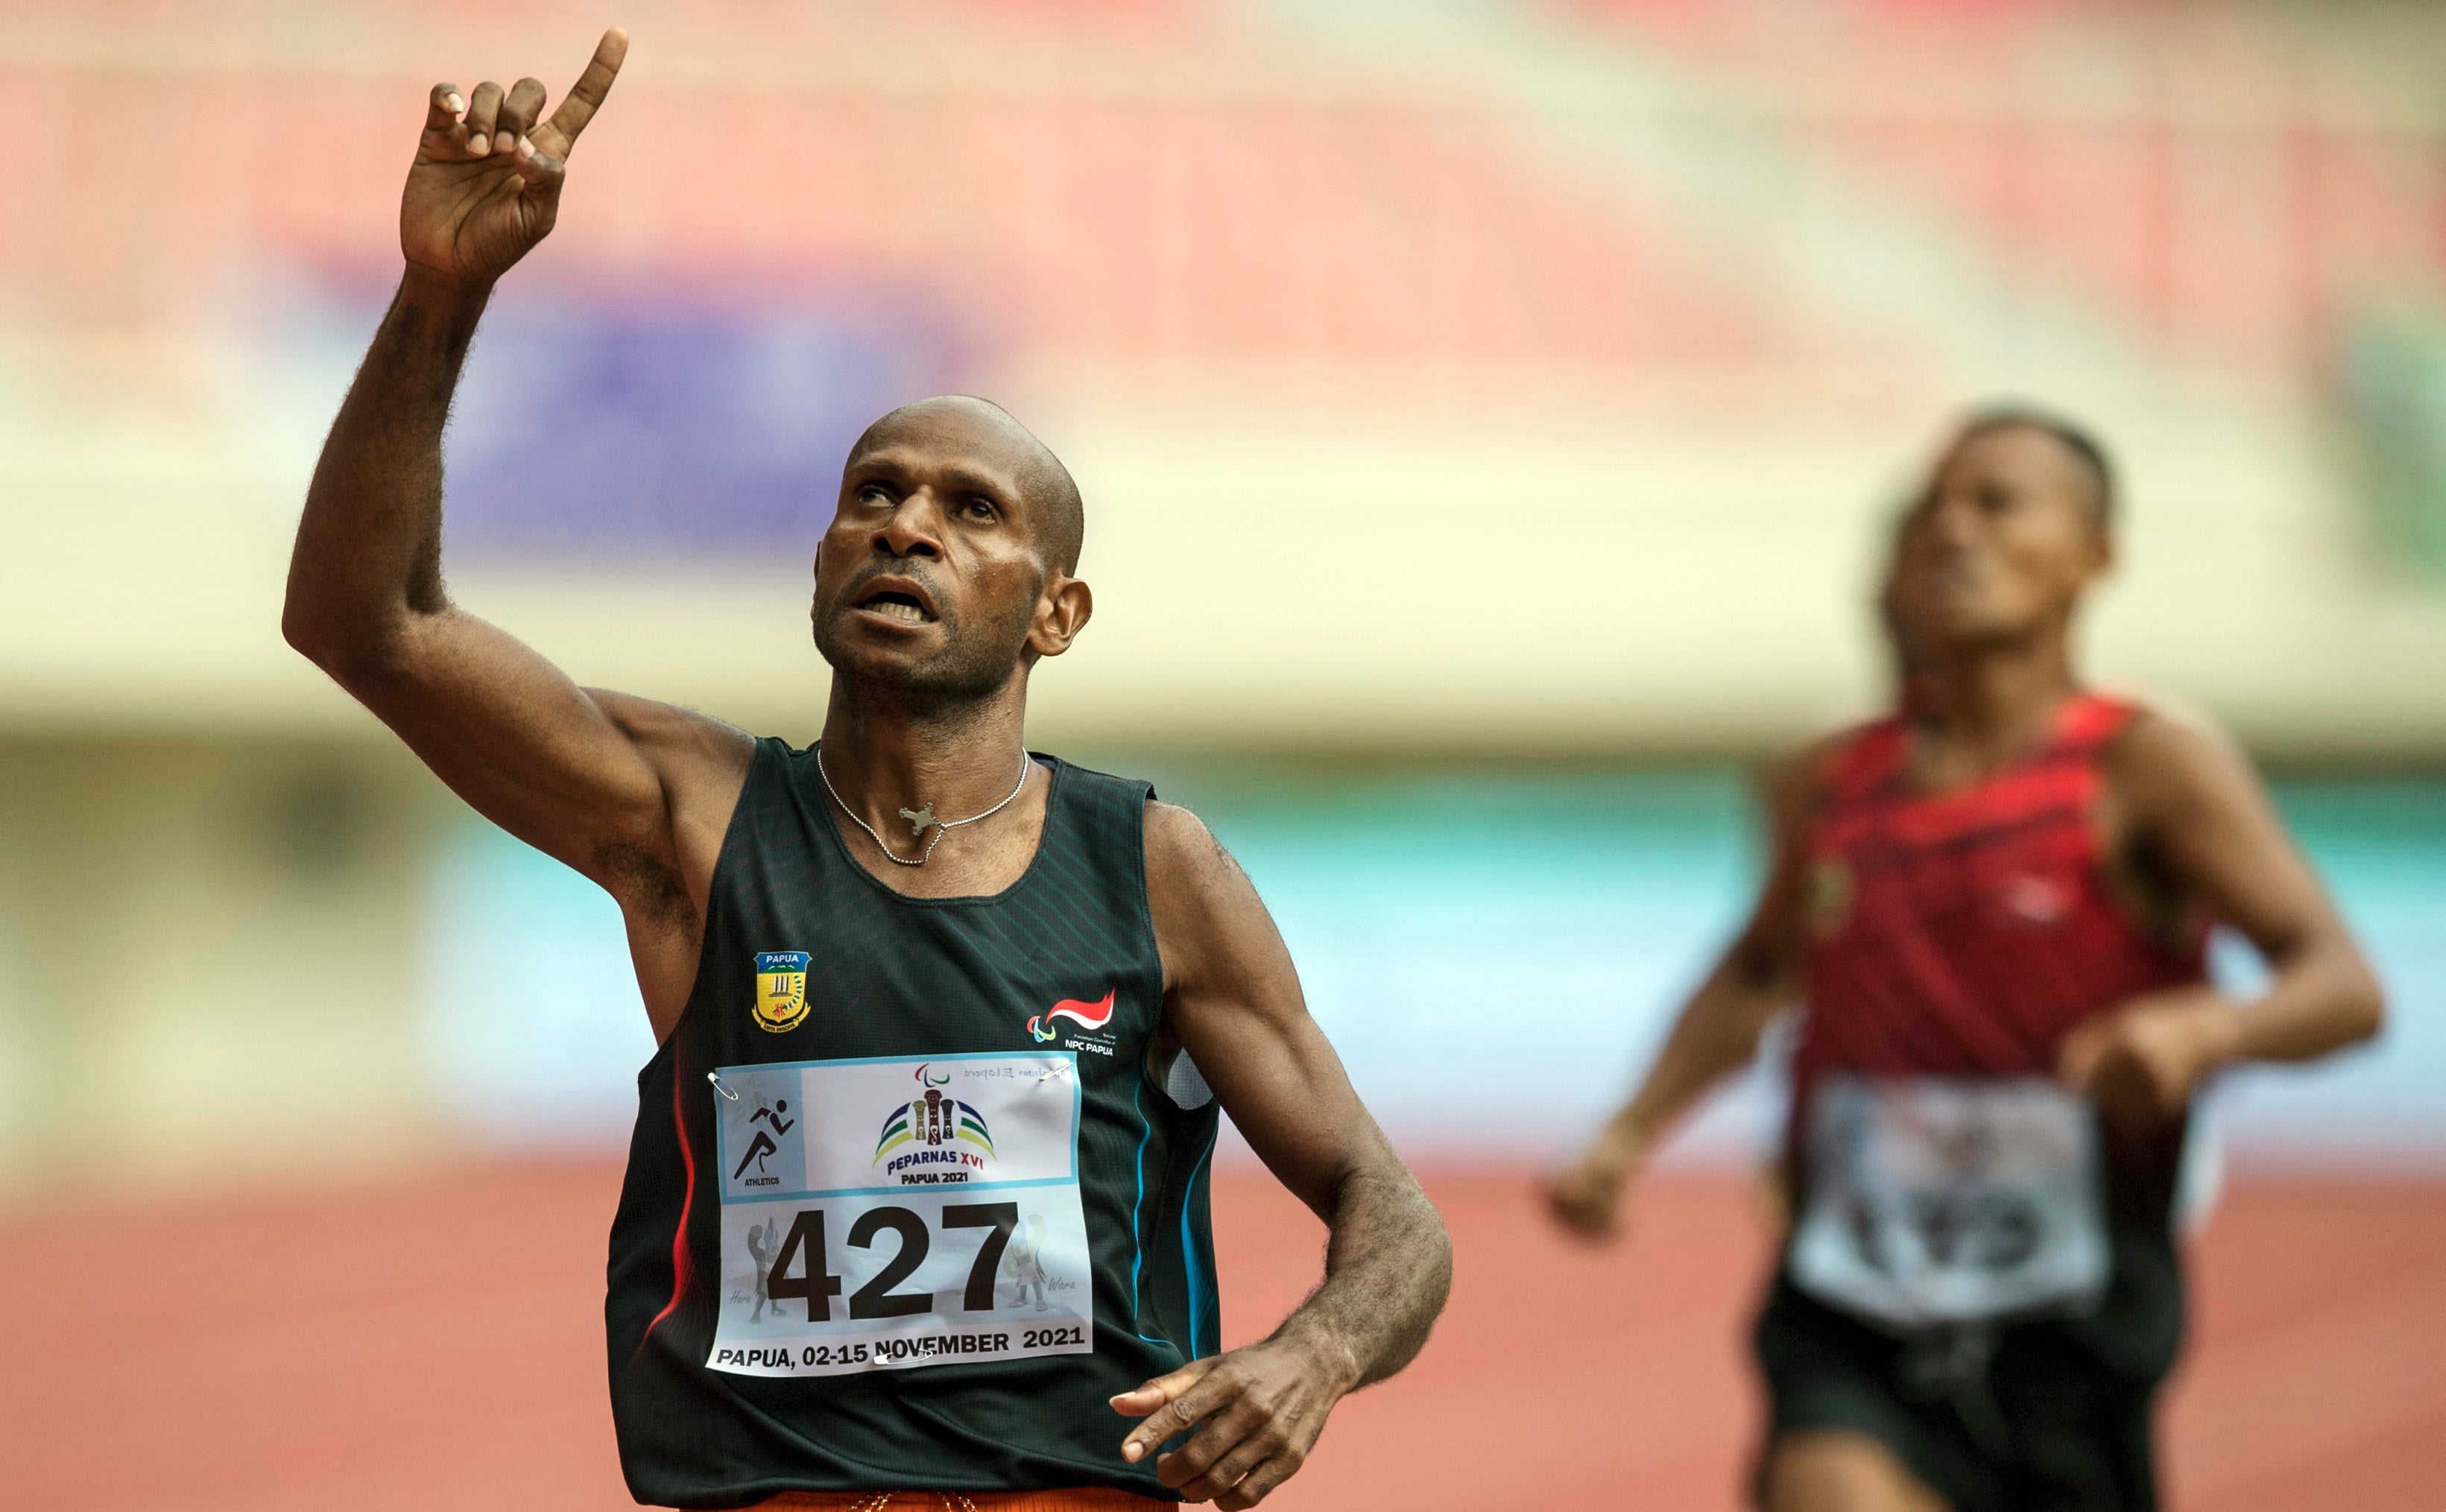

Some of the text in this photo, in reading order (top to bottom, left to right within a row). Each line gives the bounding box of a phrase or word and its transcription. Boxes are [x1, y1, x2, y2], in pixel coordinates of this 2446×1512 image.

[766, 955, 799, 963] PAPUA
[1065, 1040, 1084, 1051] NPC
[1086, 1043, 1113, 1056] PAPUA
[888, 1151, 984, 1175] PEPARNAS XVI
[745, 1177, 780, 1186] ATHLETICS
[901, 1172, 968, 1184] PAPUA 2021
[767, 1202, 1019, 1322] 427
[717, 1326, 1085, 1370] PAPUA, 02-15 NOVEMBER 2021
